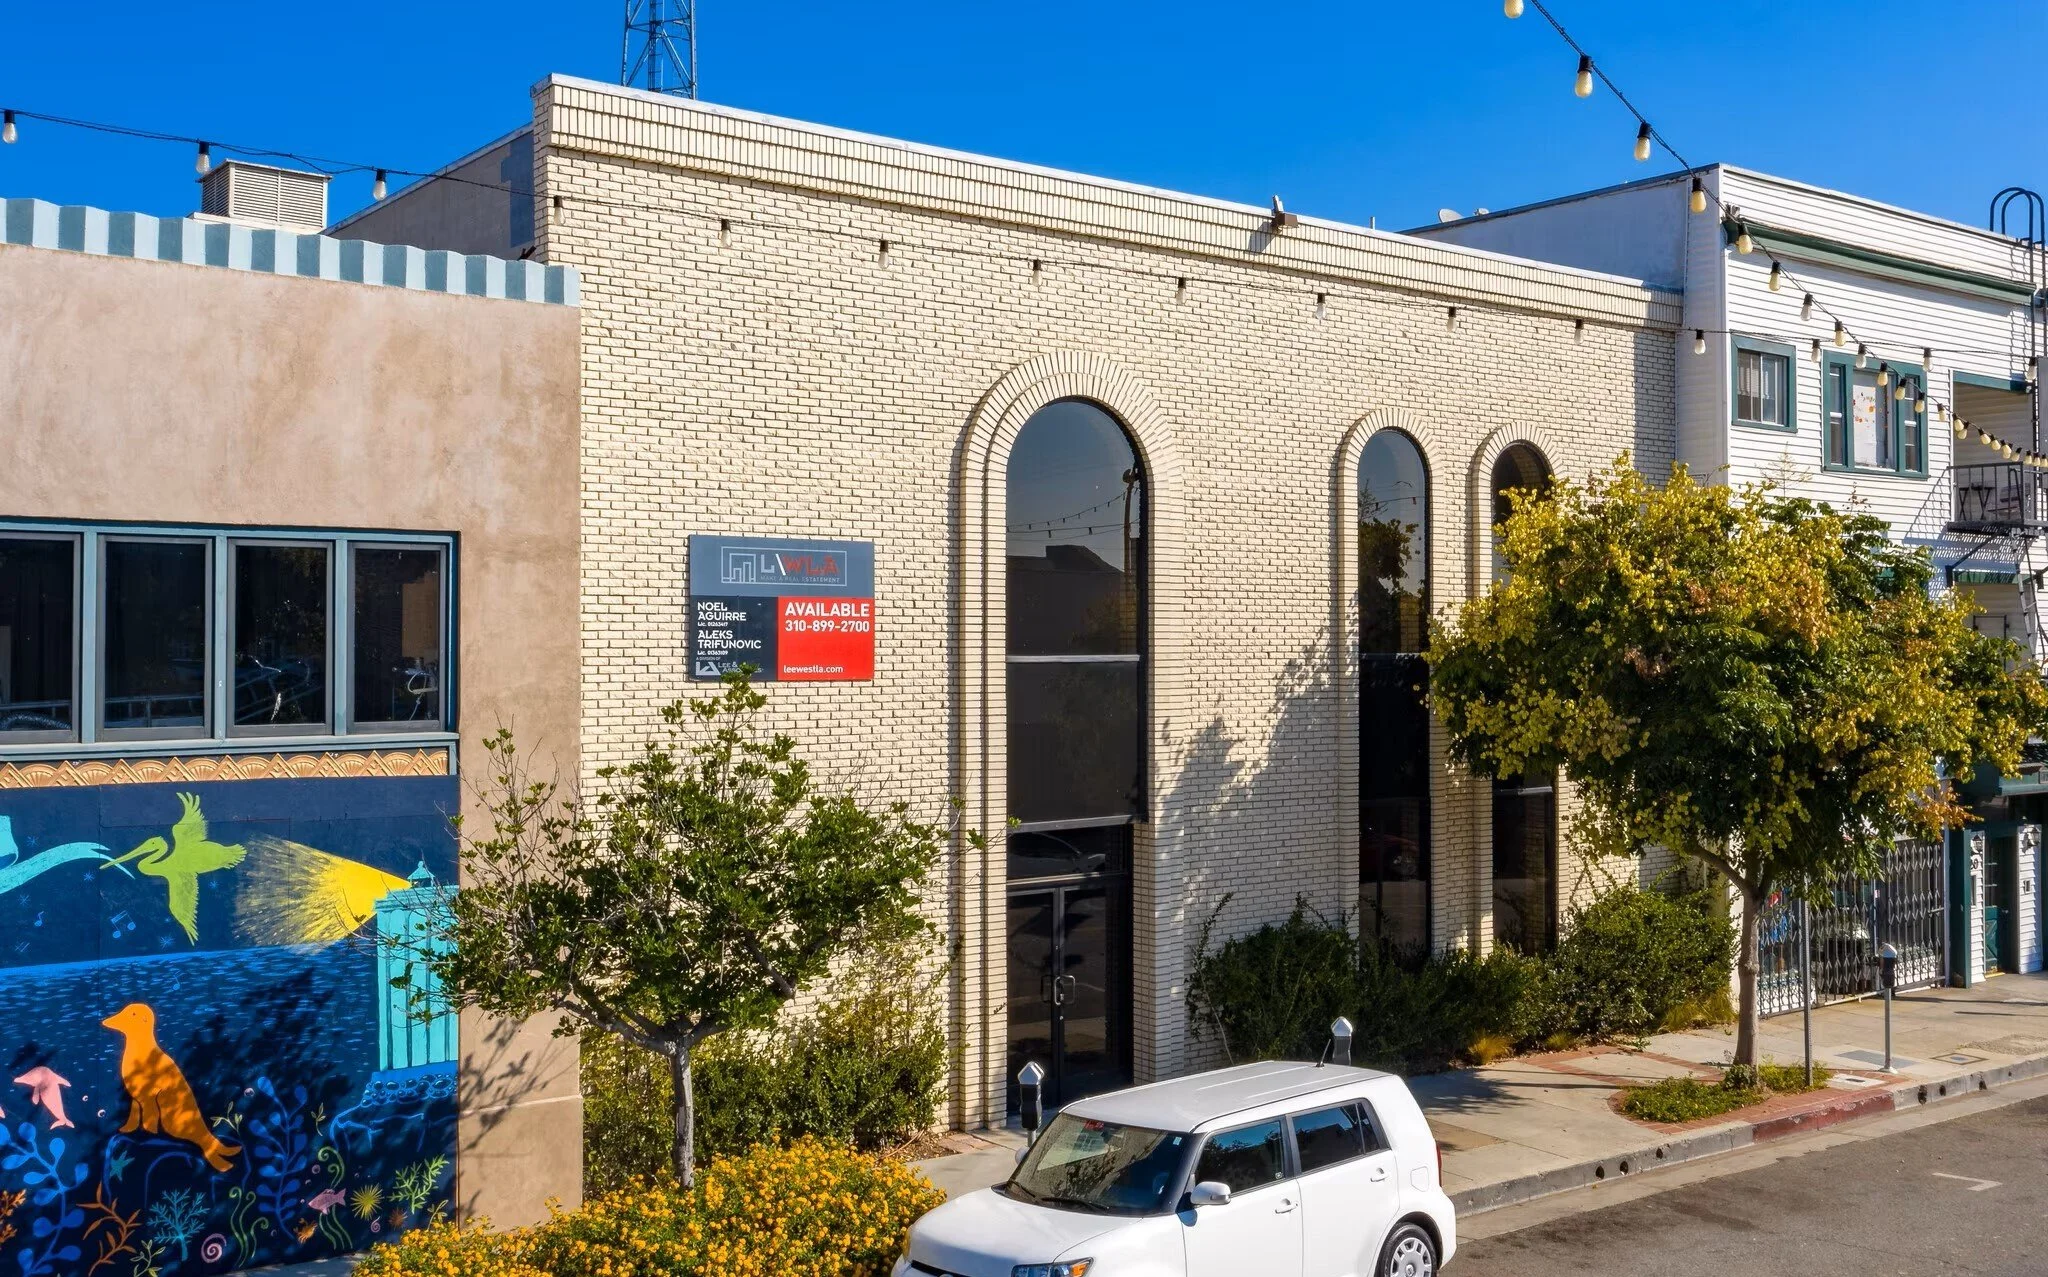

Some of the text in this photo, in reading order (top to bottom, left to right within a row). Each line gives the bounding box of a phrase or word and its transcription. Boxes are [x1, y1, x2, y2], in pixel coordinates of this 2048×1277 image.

[697, 602, 728, 611] NOEL
[785, 602, 870, 617] AVAILABLE
[697, 611, 746, 621] AGUIRRE
[785, 620, 870, 632] 310-899-2700
[697, 630, 733, 639] ALEKS
[697, 640, 762, 649] TRIFUNOVIC
[783, 665, 844, 674] leewestla.com
